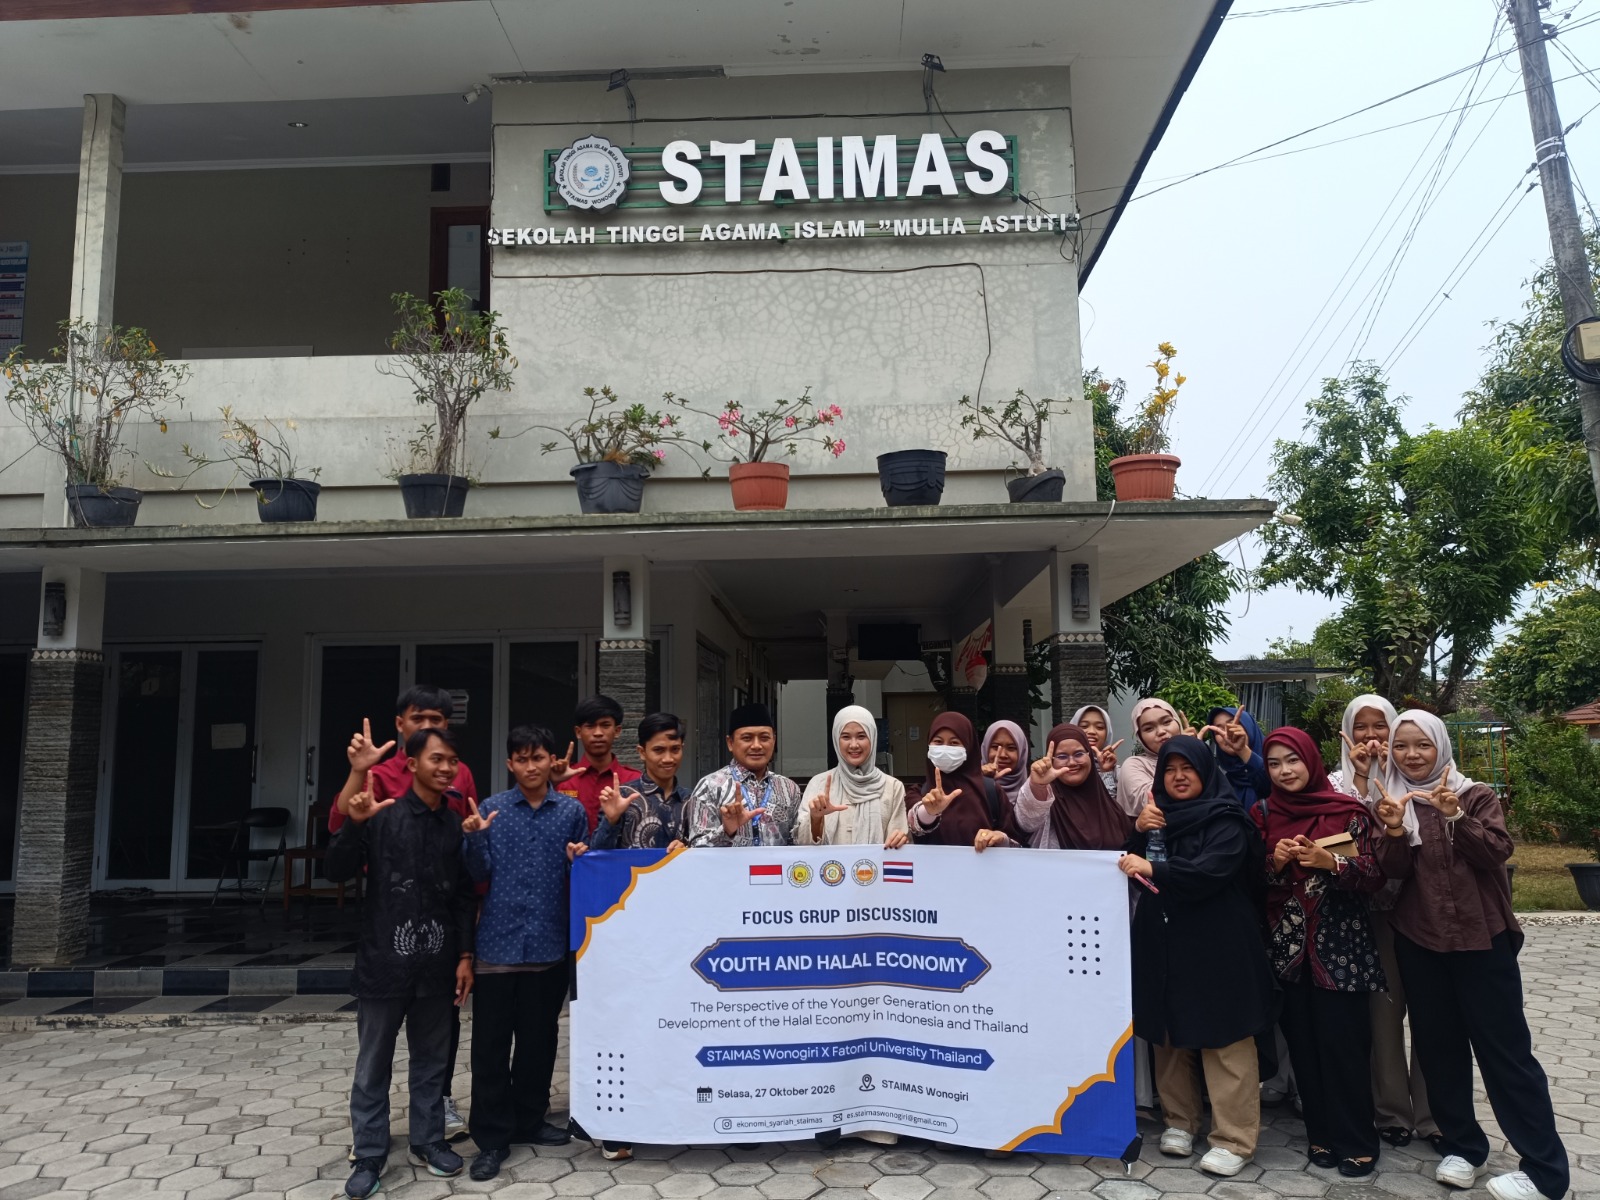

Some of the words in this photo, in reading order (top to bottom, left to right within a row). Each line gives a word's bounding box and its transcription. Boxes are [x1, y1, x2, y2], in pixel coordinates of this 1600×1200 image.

[594, 144, 608, 152] ISLAM
[658, 129, 1009, 205] STAIMAS
[566, 191, 588, 204] STAIMAS
[592, 189, 617, 204] WONOGIRI
[487, 227, 595, 246] SEKOLAH
[607, 225, 685, 243] TINGGI
[699, 222, 782, 241] AGAMA
[794, 220, 865, 239] ISLAM
[742, 910, 793, 925] FOCUS
[799, 909, 840, 924] GRUP
[846, 907, 938, 924] DISCUSSION
[708, 956, 770, 973] YOUTH
[775, 955, 812, 971] AND
[817, 952, 872, 970] HALAL
[876, 951, 967, 973] ECONOMY
[690, 1001, 713, 1013] The
[716, 999, 789, 1013] Perspective
[792, 998, 805, 1010] of
[807, 998, 828, 1009] the
[831, 995, 880, 1009] Younger
[883, 994, 950, 1012] Generation
[953, 1003, 969, 1013] on
[972, 1003, 994, 1016] the
[658, 1017, 741, 1031] Development
[744, 1016, 757, 1028] of
[759, 1016, 780, 1027] the
[783, 1014, 812, 1026] Halal
[816, 1011, 870, 1025] Economy
[873, 1009, 883, 1021] in
[886, 1010, 944, 1028] Indonesia
[947, 1019, 971, 1031] and
[974, 1019, 1029, 1034] Thailand
[706, 1049, 761, 1061] STAIMAS
[763, 1047, 819, 1060] Wonogiri
[821, 1047, 830, 1057] X
[832, 1041, 867, 1057] Fatoni
[870, 1041, 927, 1060] University
[929, 1048, 982, 1064] Thailand
[717, 1088, 753, 1099] Selasa,
[755, 1088, 766, 1097] 27
[769, 1086, 809, 1097] Oktober
[811, 1084, 836, 1095] 2026
[881, 1079, 924, 1094] STAIMAS
[925, 1086, 969, 1102] Wonogiri
[736, 1116, 823, 1129] ekonomi_syariah_staimas
[846, 1110, 948, 1127] es.staimaswonogiri@gmail.com
